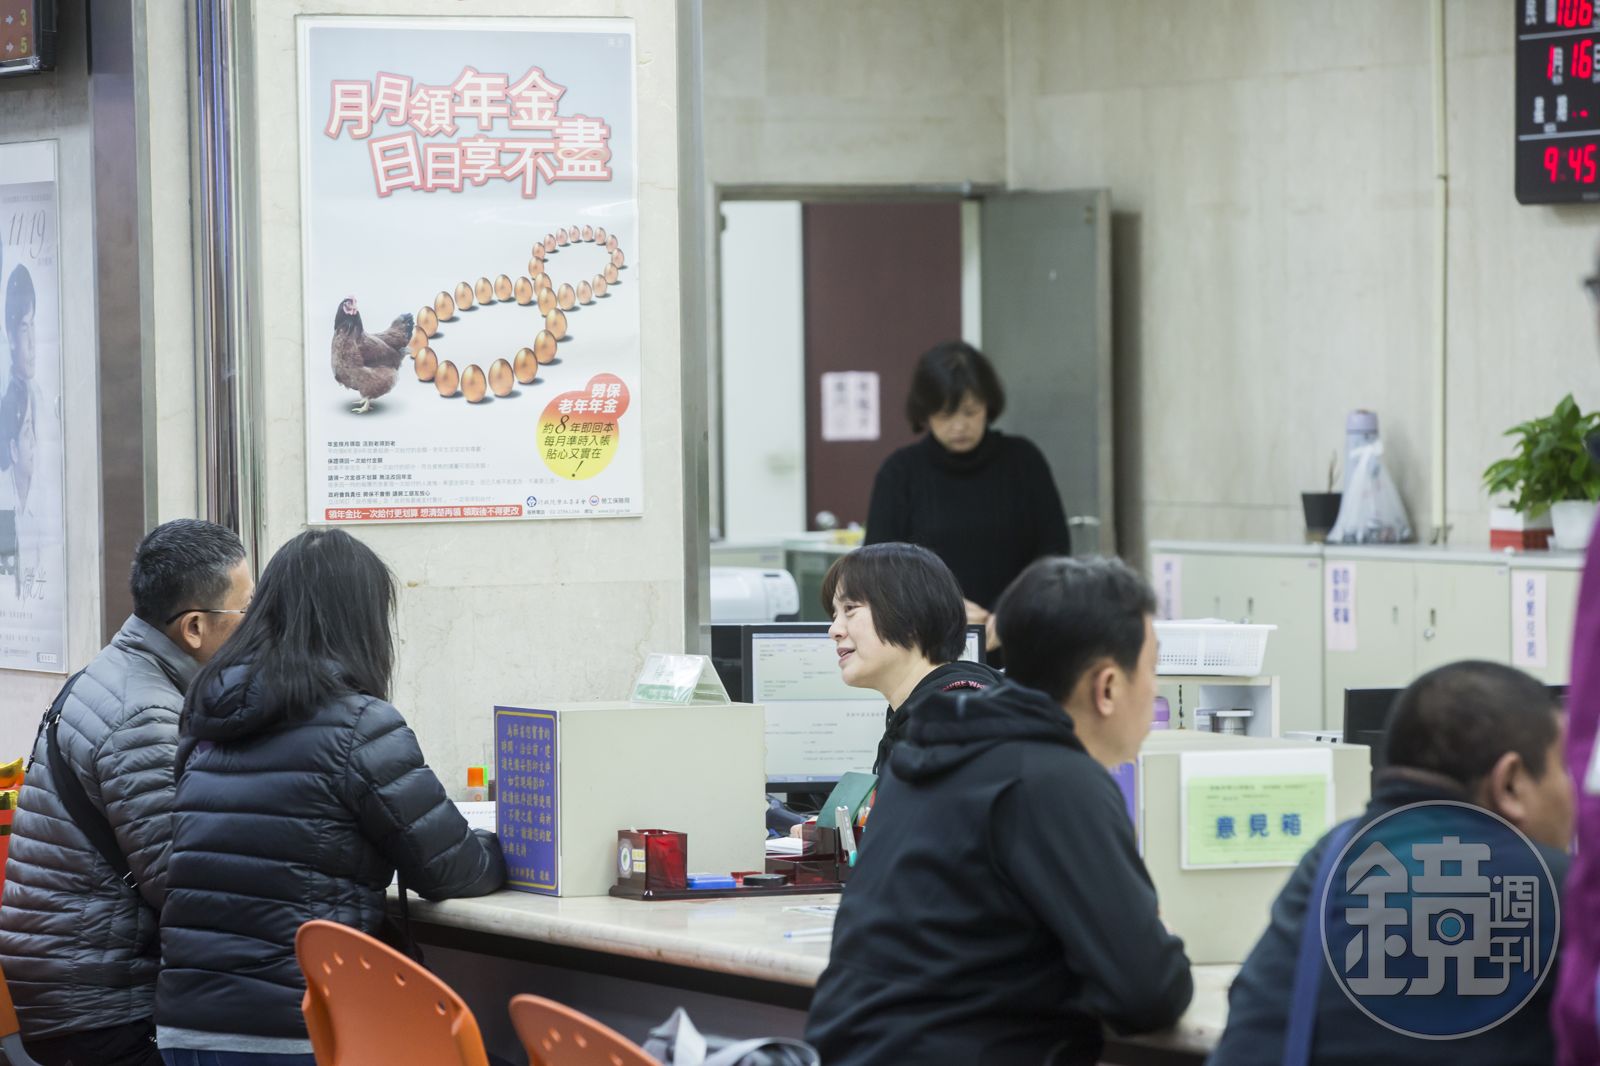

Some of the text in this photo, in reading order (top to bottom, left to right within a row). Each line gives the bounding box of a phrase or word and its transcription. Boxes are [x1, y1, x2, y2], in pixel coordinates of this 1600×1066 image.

[324, 65, 567, 140] 月月領年金
[367, 114, 612, 199] 日日享不盡
[591, 383, 621, 399] 勞保
[558, 398, 619, 414] 老年年金
[544, 435, 612, 447] 每月準時入帳
